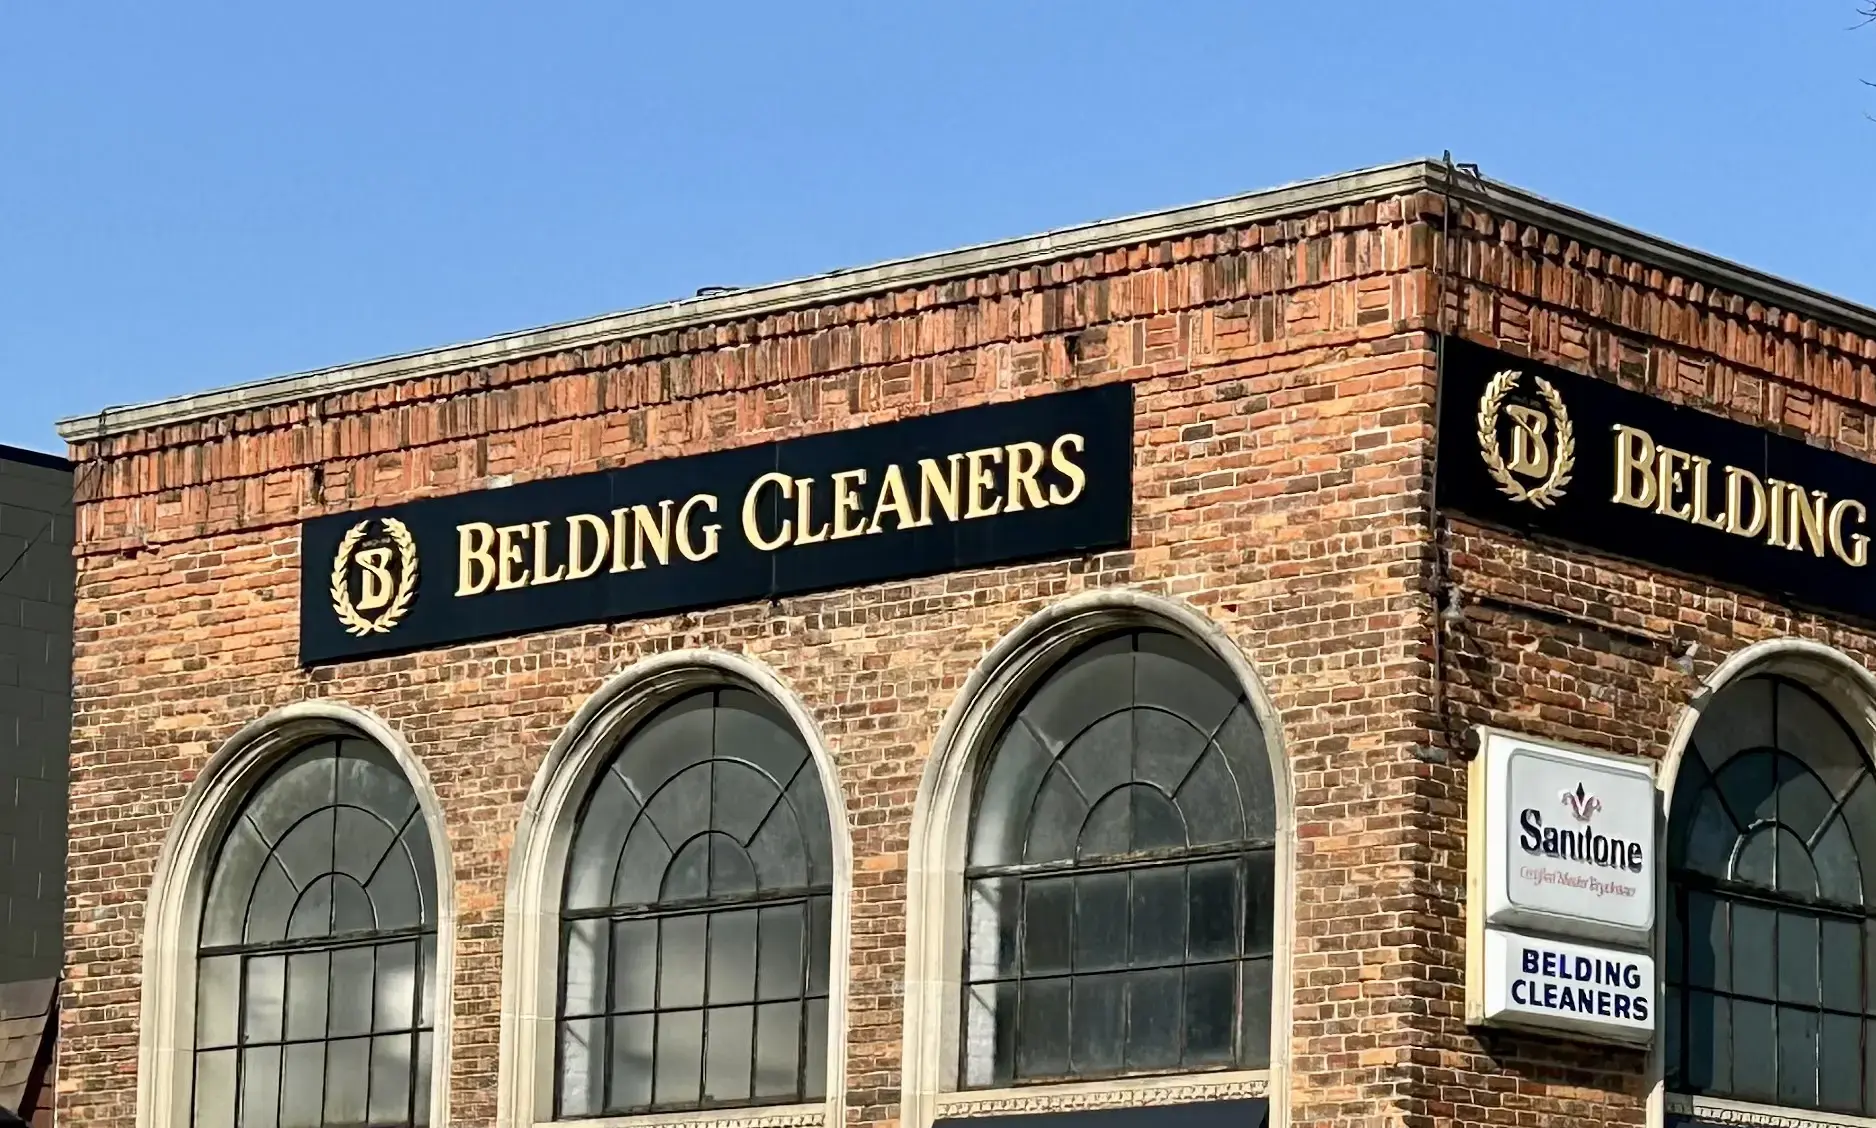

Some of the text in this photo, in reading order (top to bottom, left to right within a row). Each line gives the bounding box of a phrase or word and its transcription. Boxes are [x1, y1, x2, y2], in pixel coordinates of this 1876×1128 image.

[454, 433, 1086, 598] BELDING CLEANERS
[1611, 423, 1870, 568] BELDING
[1519, 808, 1644, 873] Sanitone
[1511, 979, 1648, 1022] CLEANERS
[1522, 948, 1641, 990] BELDING
